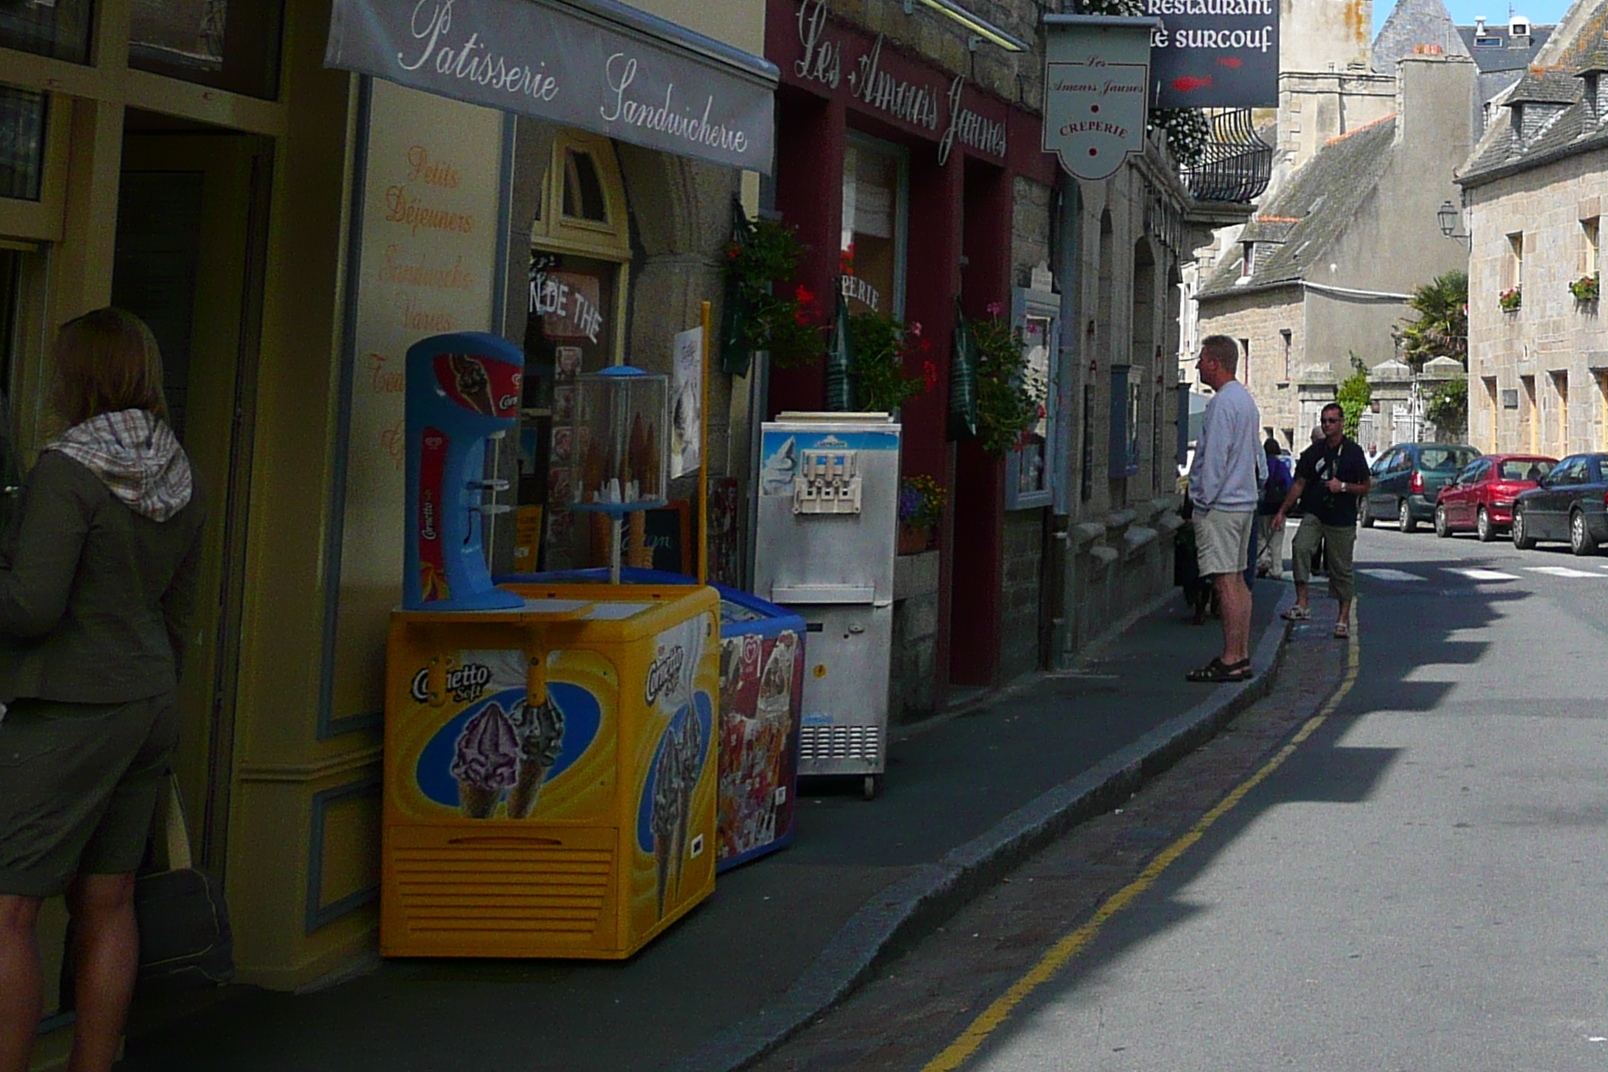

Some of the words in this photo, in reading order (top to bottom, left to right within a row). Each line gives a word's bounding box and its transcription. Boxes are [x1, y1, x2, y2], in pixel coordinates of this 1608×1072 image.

[601, 52, 748, 152] Sandwicherie
[847, 32, 938, 130] Amours
[937, 74, 1007, 166] Jaunes
